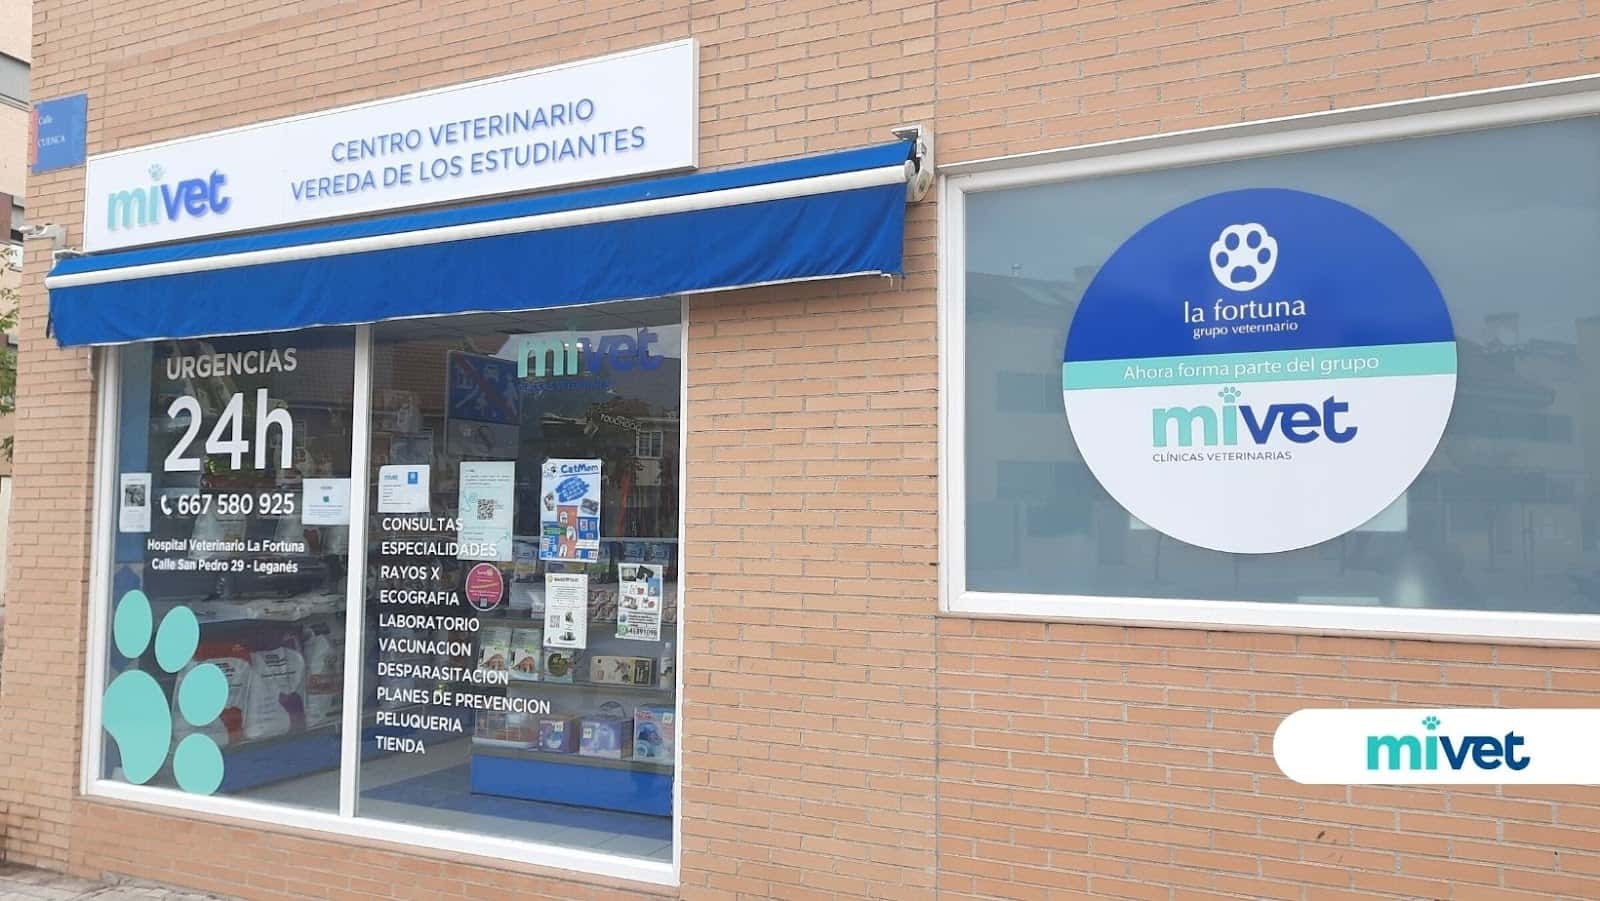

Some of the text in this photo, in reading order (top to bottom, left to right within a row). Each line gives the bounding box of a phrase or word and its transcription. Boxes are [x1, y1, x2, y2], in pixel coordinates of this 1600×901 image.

[331, 98, 594, 163] CENTRO VETERINARIO
[291, 126, 646, 201] VEREDA DE LOS ESTUDIANTES
[107, 165, 231, 231] mivet
[1184, 298, 1306, 323] la fortuna
[1193, 320, 1298, 340] grupo veterinario
[517, 319, 664, 378] mivet
[167, 347, 298, 381] URGENCIAS
[1124, 356, 1379, 381] Ahora forma parte del grupo
[1152, 387, 1358, 448] mivet
[164, 388, 293, 472] 24h
[1152, 450, 1292, 463] CLÍNICAS VETERINARIAS
[178, 494, 213, 515] 667
[217, 494, 252, 515] 580
[258, 493, 295, 515] 925
[382, 517, 464, 532] CONSULTAS
[148, 539, 305, 553] Hospital Veterinario La Fortuna
[381, 541, 498, 557] ESPECIALIDADES
[152, 558, 175, 571] Calle
[178, 559, 196, 571] San
[199, 559, 228, 572] Pedro
[231, 559, 244, 572] 29
[254, 560, 298, 574] Leganés
[380, 565, 440, 581] RAYOS X
[380, 590, 460, 606] ECOGRAFIA
[379, 614, 480, 632] LABORATORIO
[378, 638, 471, 656] VACUNACION
[377, 662, 509, 685] DESPARASITACION
[377, 687, 551, 714] PLANES DE PREVENCION
[376, 711, 463, 733] PELUQUERIA
[375, 736, 426, 754] TIENDA
